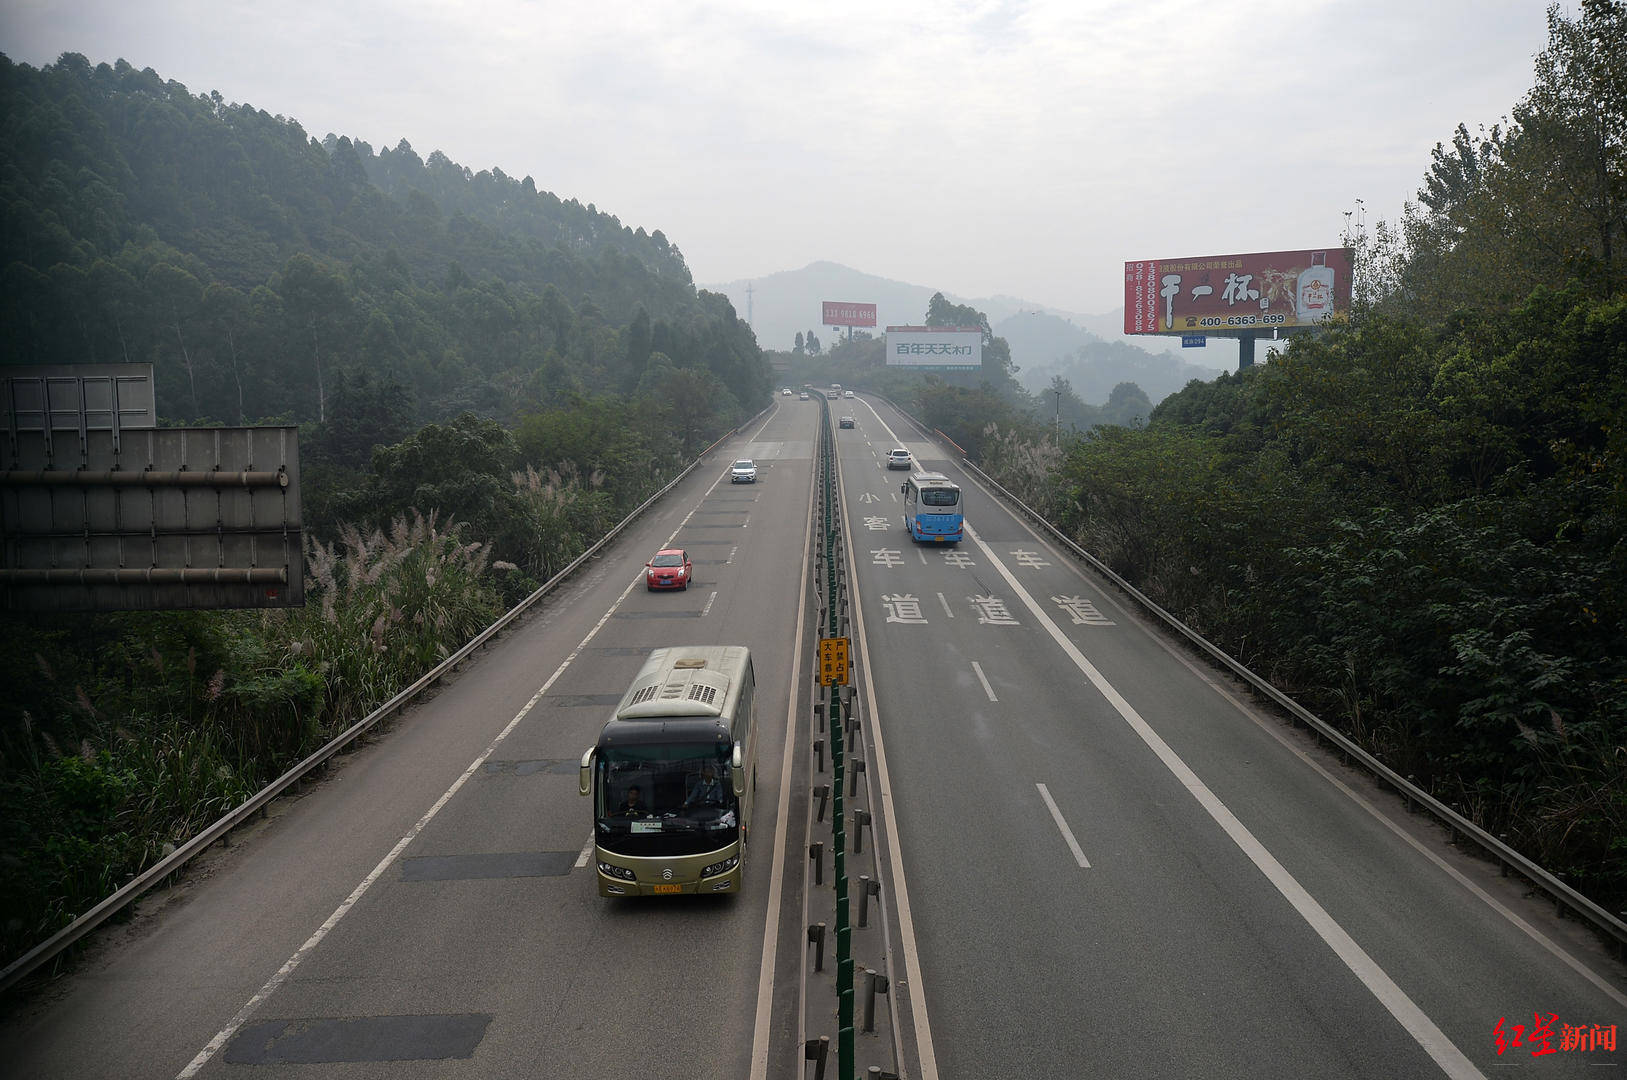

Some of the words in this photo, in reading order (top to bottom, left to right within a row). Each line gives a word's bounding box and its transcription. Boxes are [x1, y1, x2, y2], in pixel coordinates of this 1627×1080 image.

[1160, 272, 1259, 329] 干一杯
[1200, 314, 1286, 327] 400-6363-699
[896, 343, 972, 356] 百年天天木门
